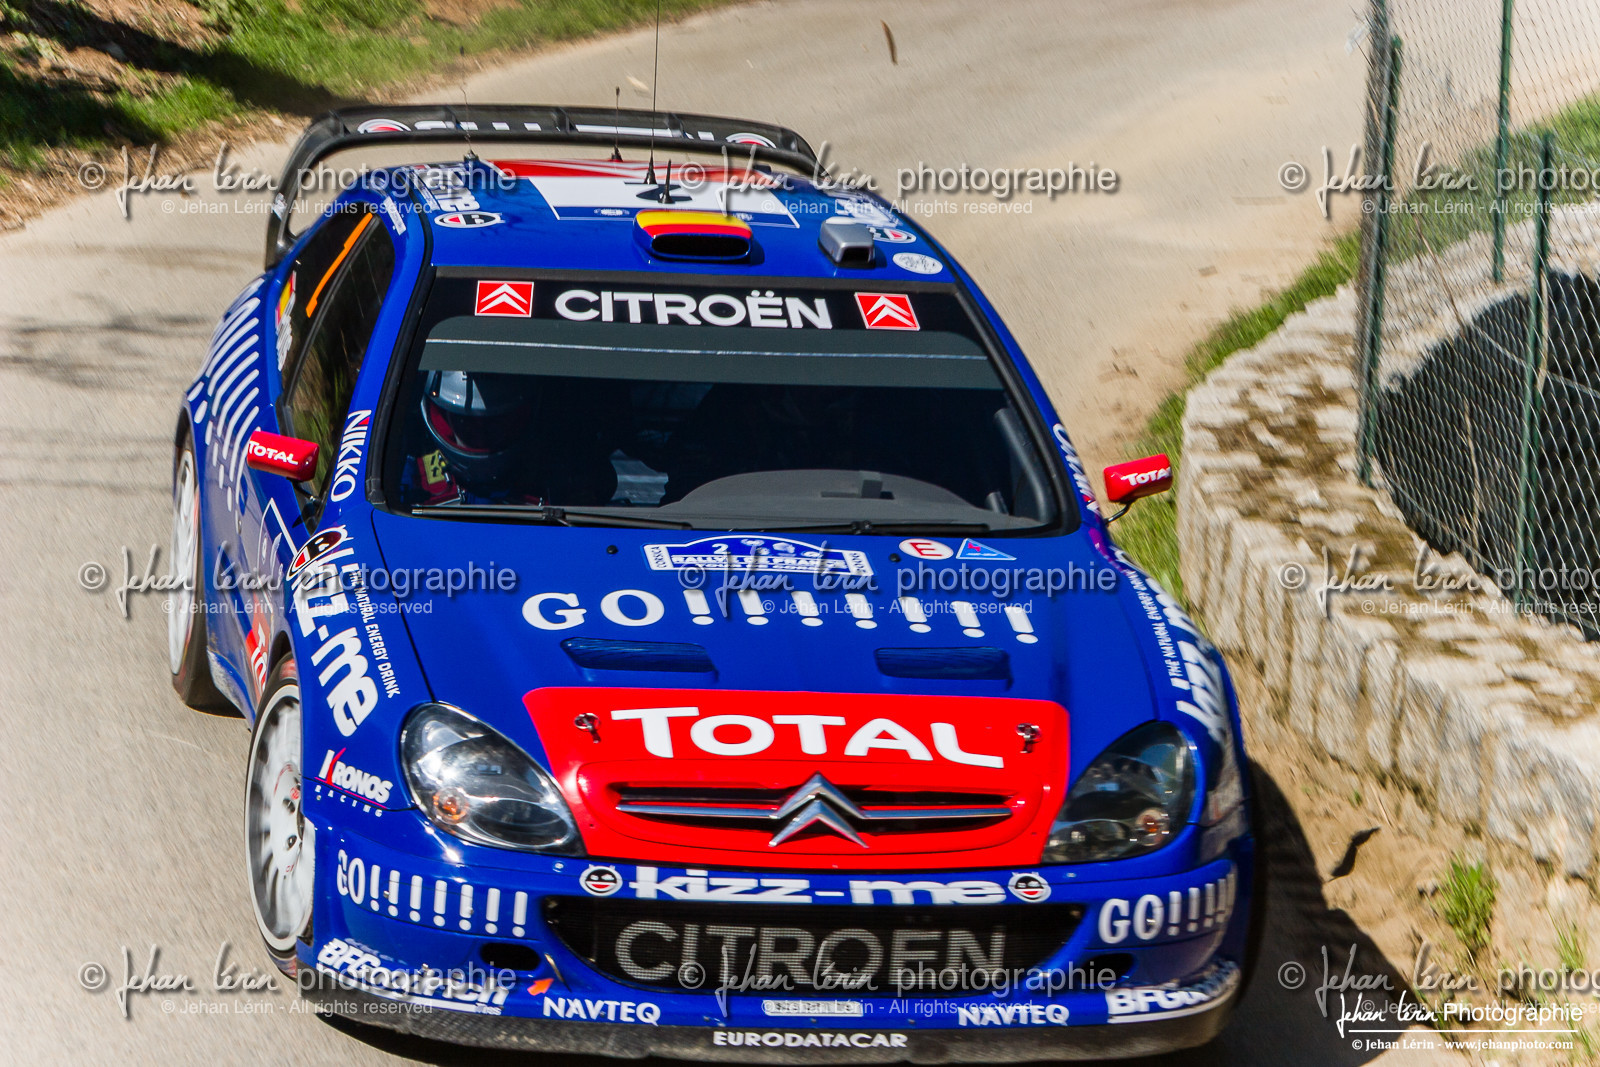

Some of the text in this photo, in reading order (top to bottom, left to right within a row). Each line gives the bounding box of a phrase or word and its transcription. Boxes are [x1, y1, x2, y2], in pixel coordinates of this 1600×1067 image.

[555, 289, 833, 330] CITROËN
[248, 441, 298, 466] TOTAL
[331, 409, 371, 502] NIKKO
[1121, 467, 1172, 486] TOTA
[354, 587, 375, 623] NATURAL
[365, 624, 389, 660] ENERGY
[377, 662, 401, 699] DRINK
[610, 706, 1005, 769] TOTAL
[318, 747, 394, 803] KRONOS
[629, 866, 1006, 905] kizz-me
[542, 996, 660, 1026] NAVTEQ
[957, 1003, 1070, 1027] NAVTEQ
[712, 1031, 908, 1049] EURODATACAR
